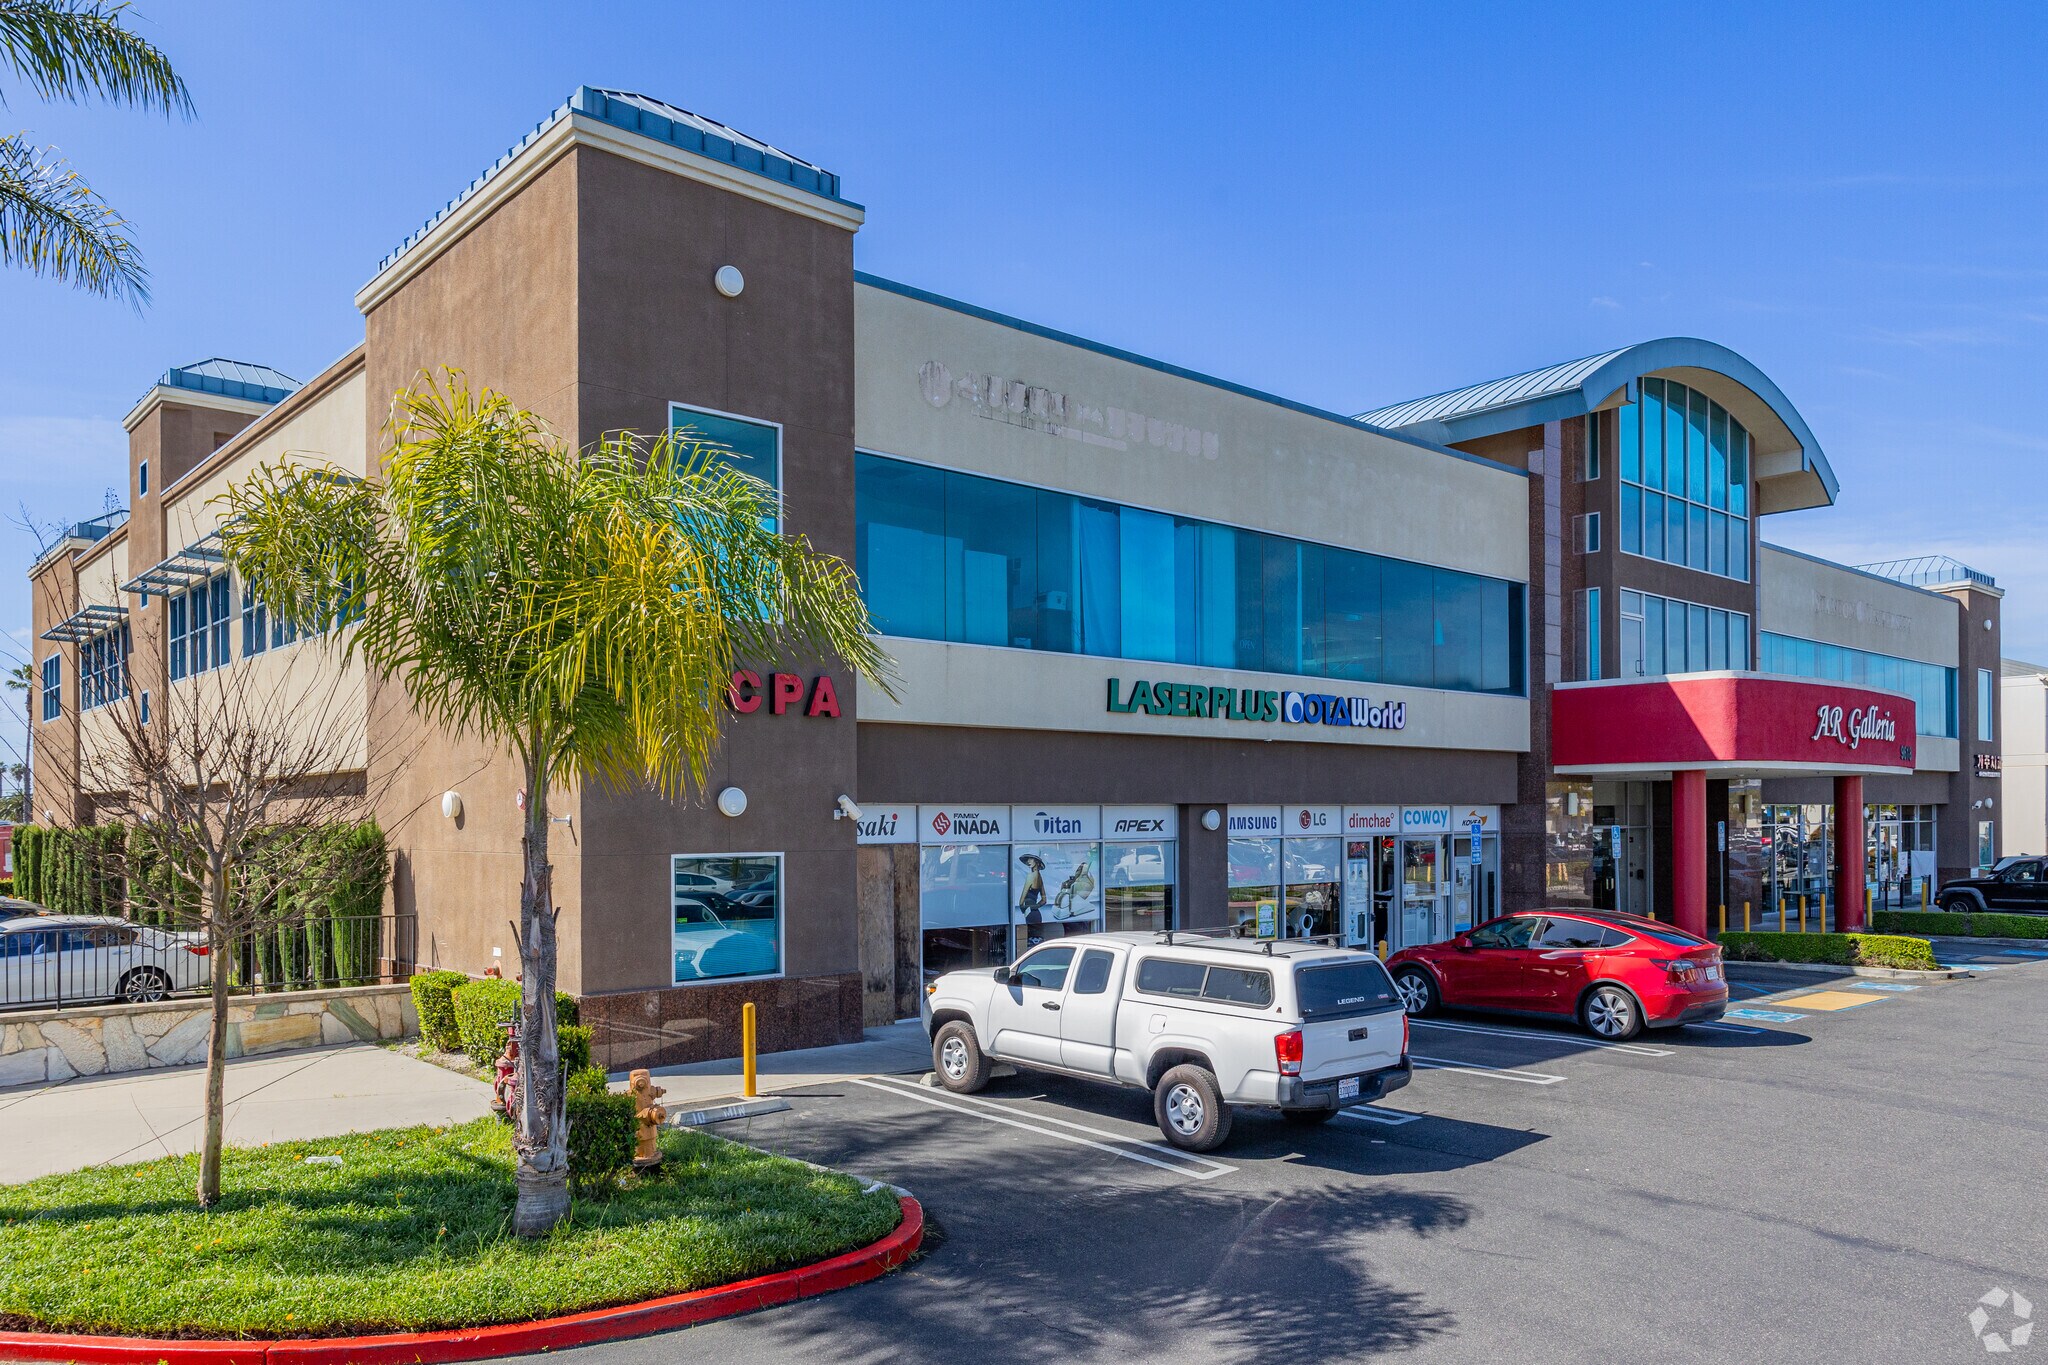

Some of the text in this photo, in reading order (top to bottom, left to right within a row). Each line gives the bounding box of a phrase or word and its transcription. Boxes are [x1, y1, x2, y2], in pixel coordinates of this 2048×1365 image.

[727, 669, 842, 718] CPA
[1811, 705, 1896, 749] AR Galleria
[856, 813, 898, 836] saki
[1033, 811, 1082, 834] Titan
[1114, 819, 1165, 832] APEX
[1229, 816, 1277, 830] AMSUNG
[1313, 813, 1327, 826] LG
[1403, 810, 1448, 828] coway
[953, 820, 1000, 835] INADA
[1337, 996, 1365, 1005] LEGEND
[723, 1105, 745, 1118] MIN
